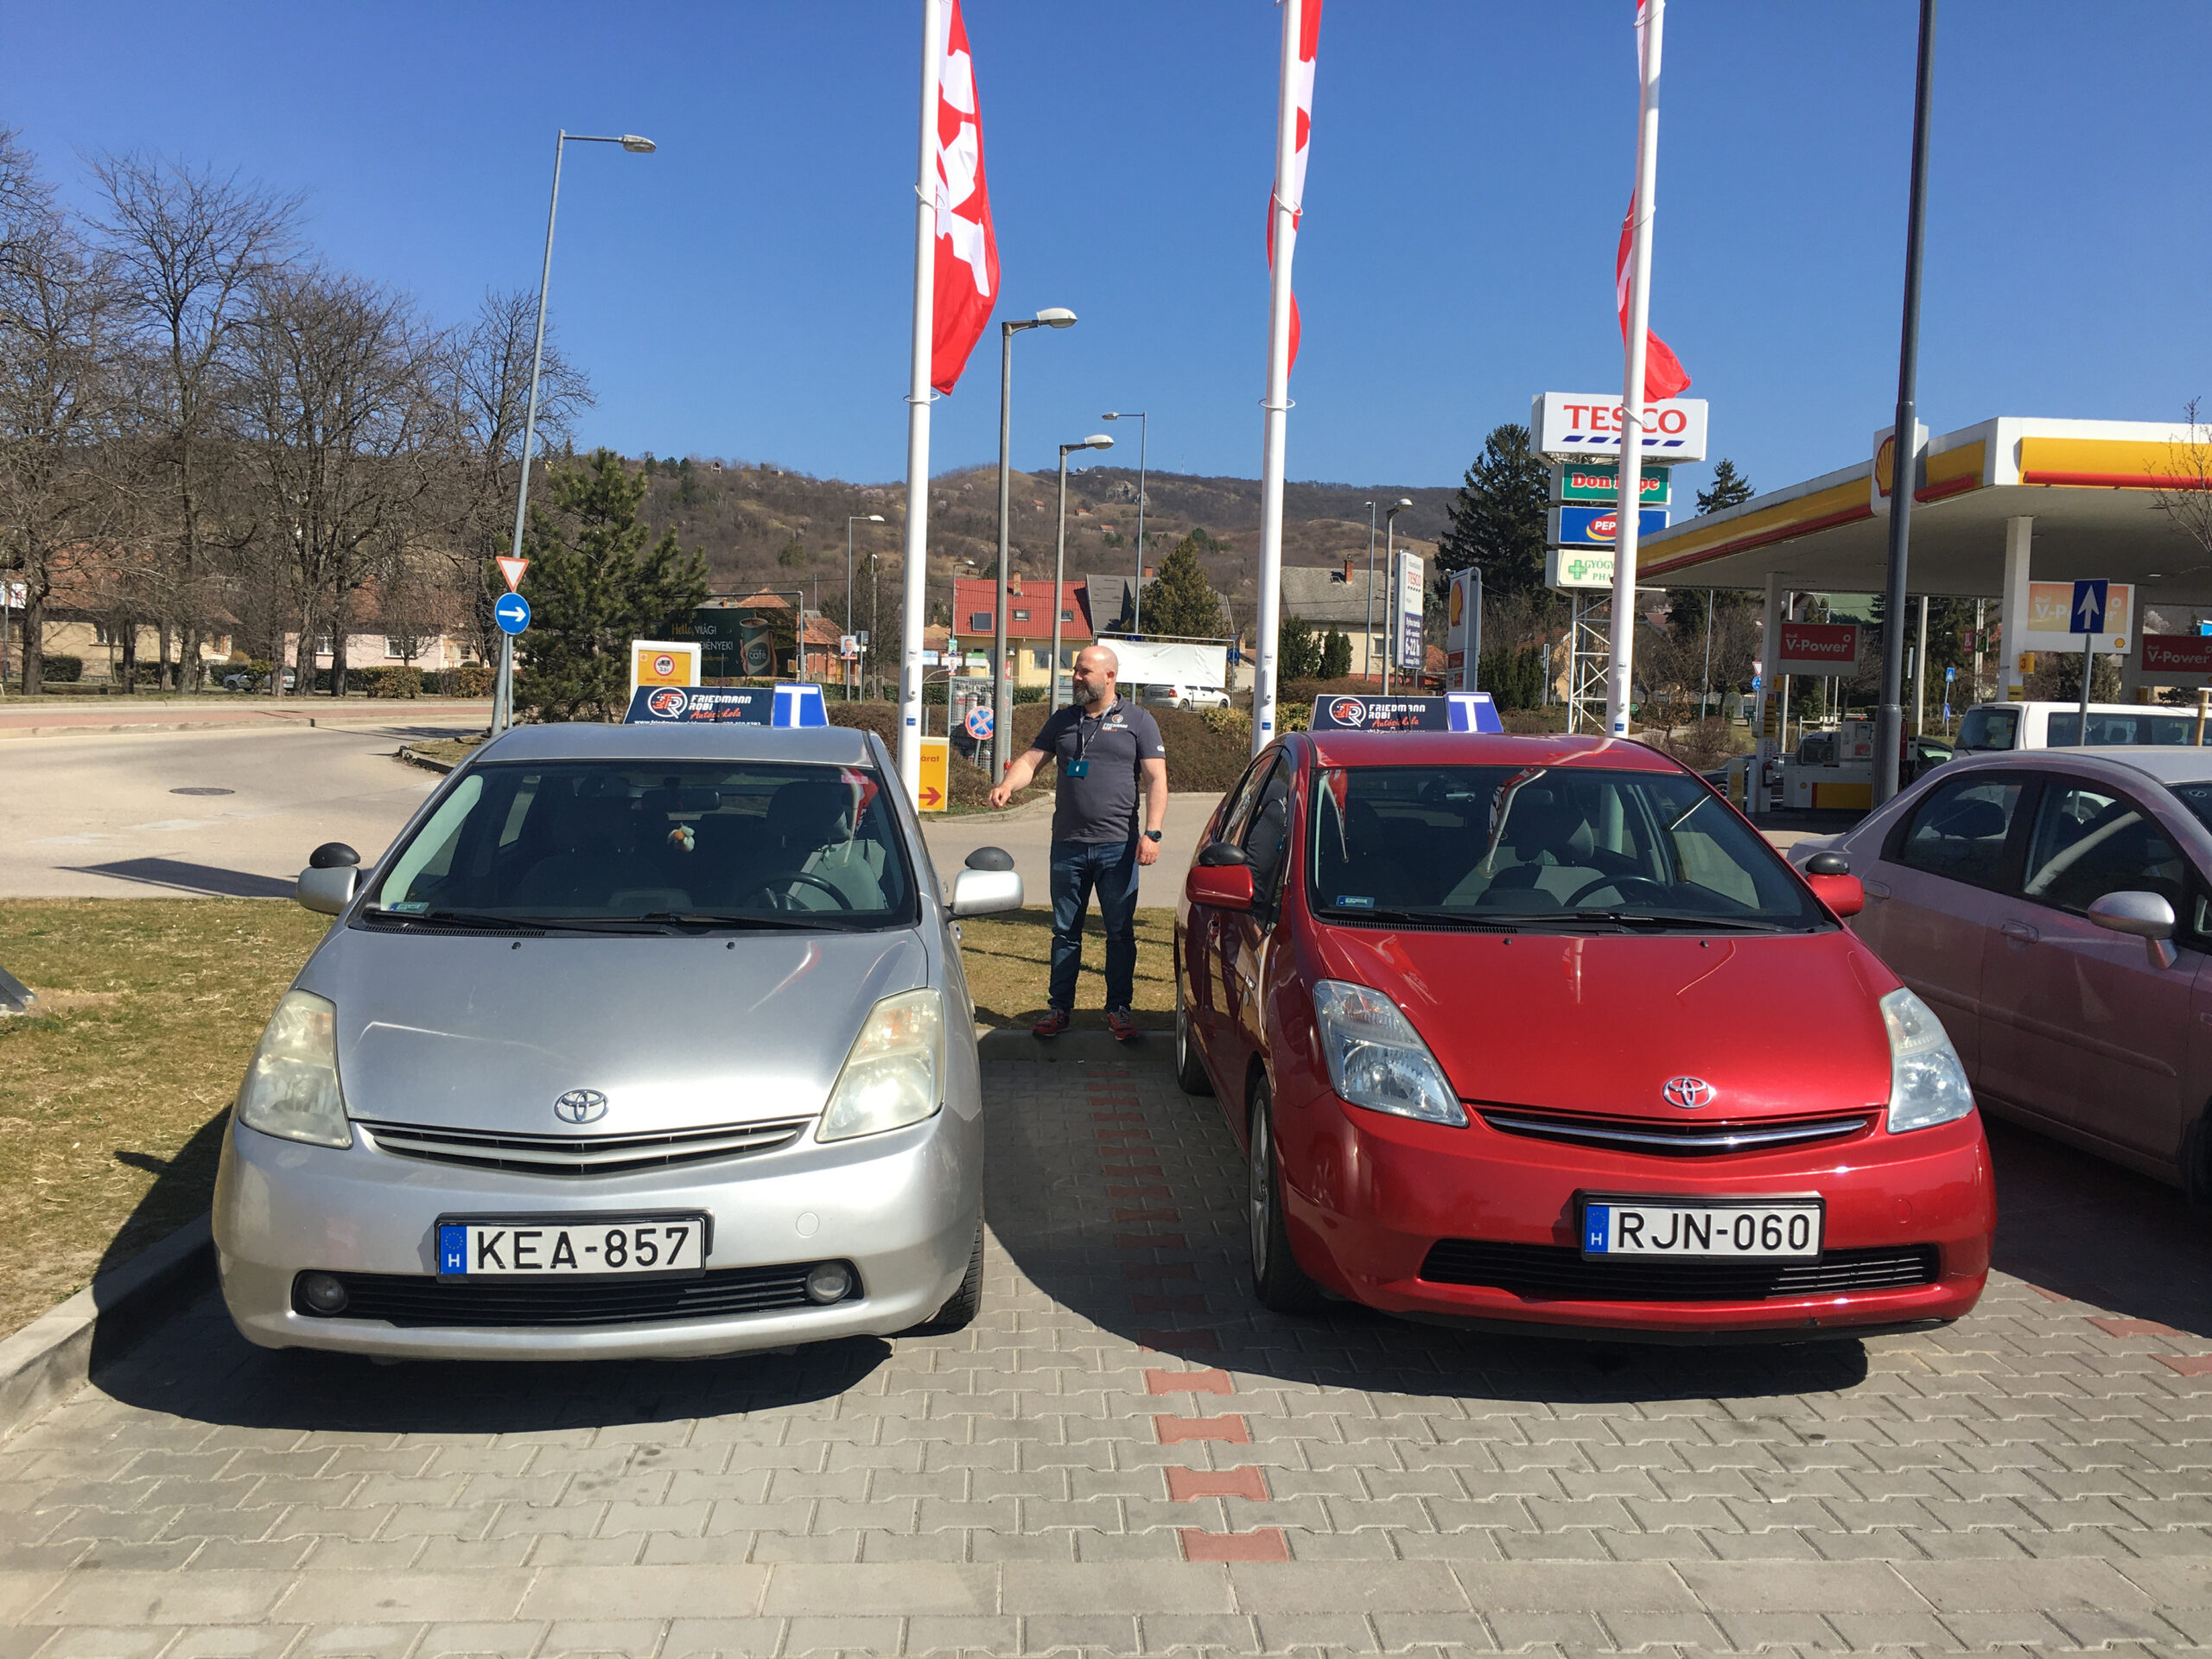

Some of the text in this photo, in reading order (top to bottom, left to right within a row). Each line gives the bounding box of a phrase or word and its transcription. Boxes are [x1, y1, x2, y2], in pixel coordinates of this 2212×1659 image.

[1563, 404, 1688, 435] TESCO
[1571, 473, 1611, 489] Don
[1594, 521, 1617, 531] PEP
[1584, 557, 1614, 569] GYÓGY
[1408, 570, 1421, 587] TESCO
[1785, 639, 1847, 653] V-Power
[2147, 650, 2210, 664] V-Power
[690, 694, 752, 704] FRIEDMANN
[688, 702, 714, 711] ROBI
[774, 685, 818, 728] T
[1369, 703, 1426, 713] FRIEDMANN
[1368, 711, 1391, 720] ROBI
[1448, 695, 1490, 733] T
[921, 753, 939, 763] árat
[1618, 1211, 1810, 1251] RJN-060
[1591, 1232, 1603, 1246] H
[478, 1226, 690, 1269] KEA-857
[448, 1253, 461, 1268] H
